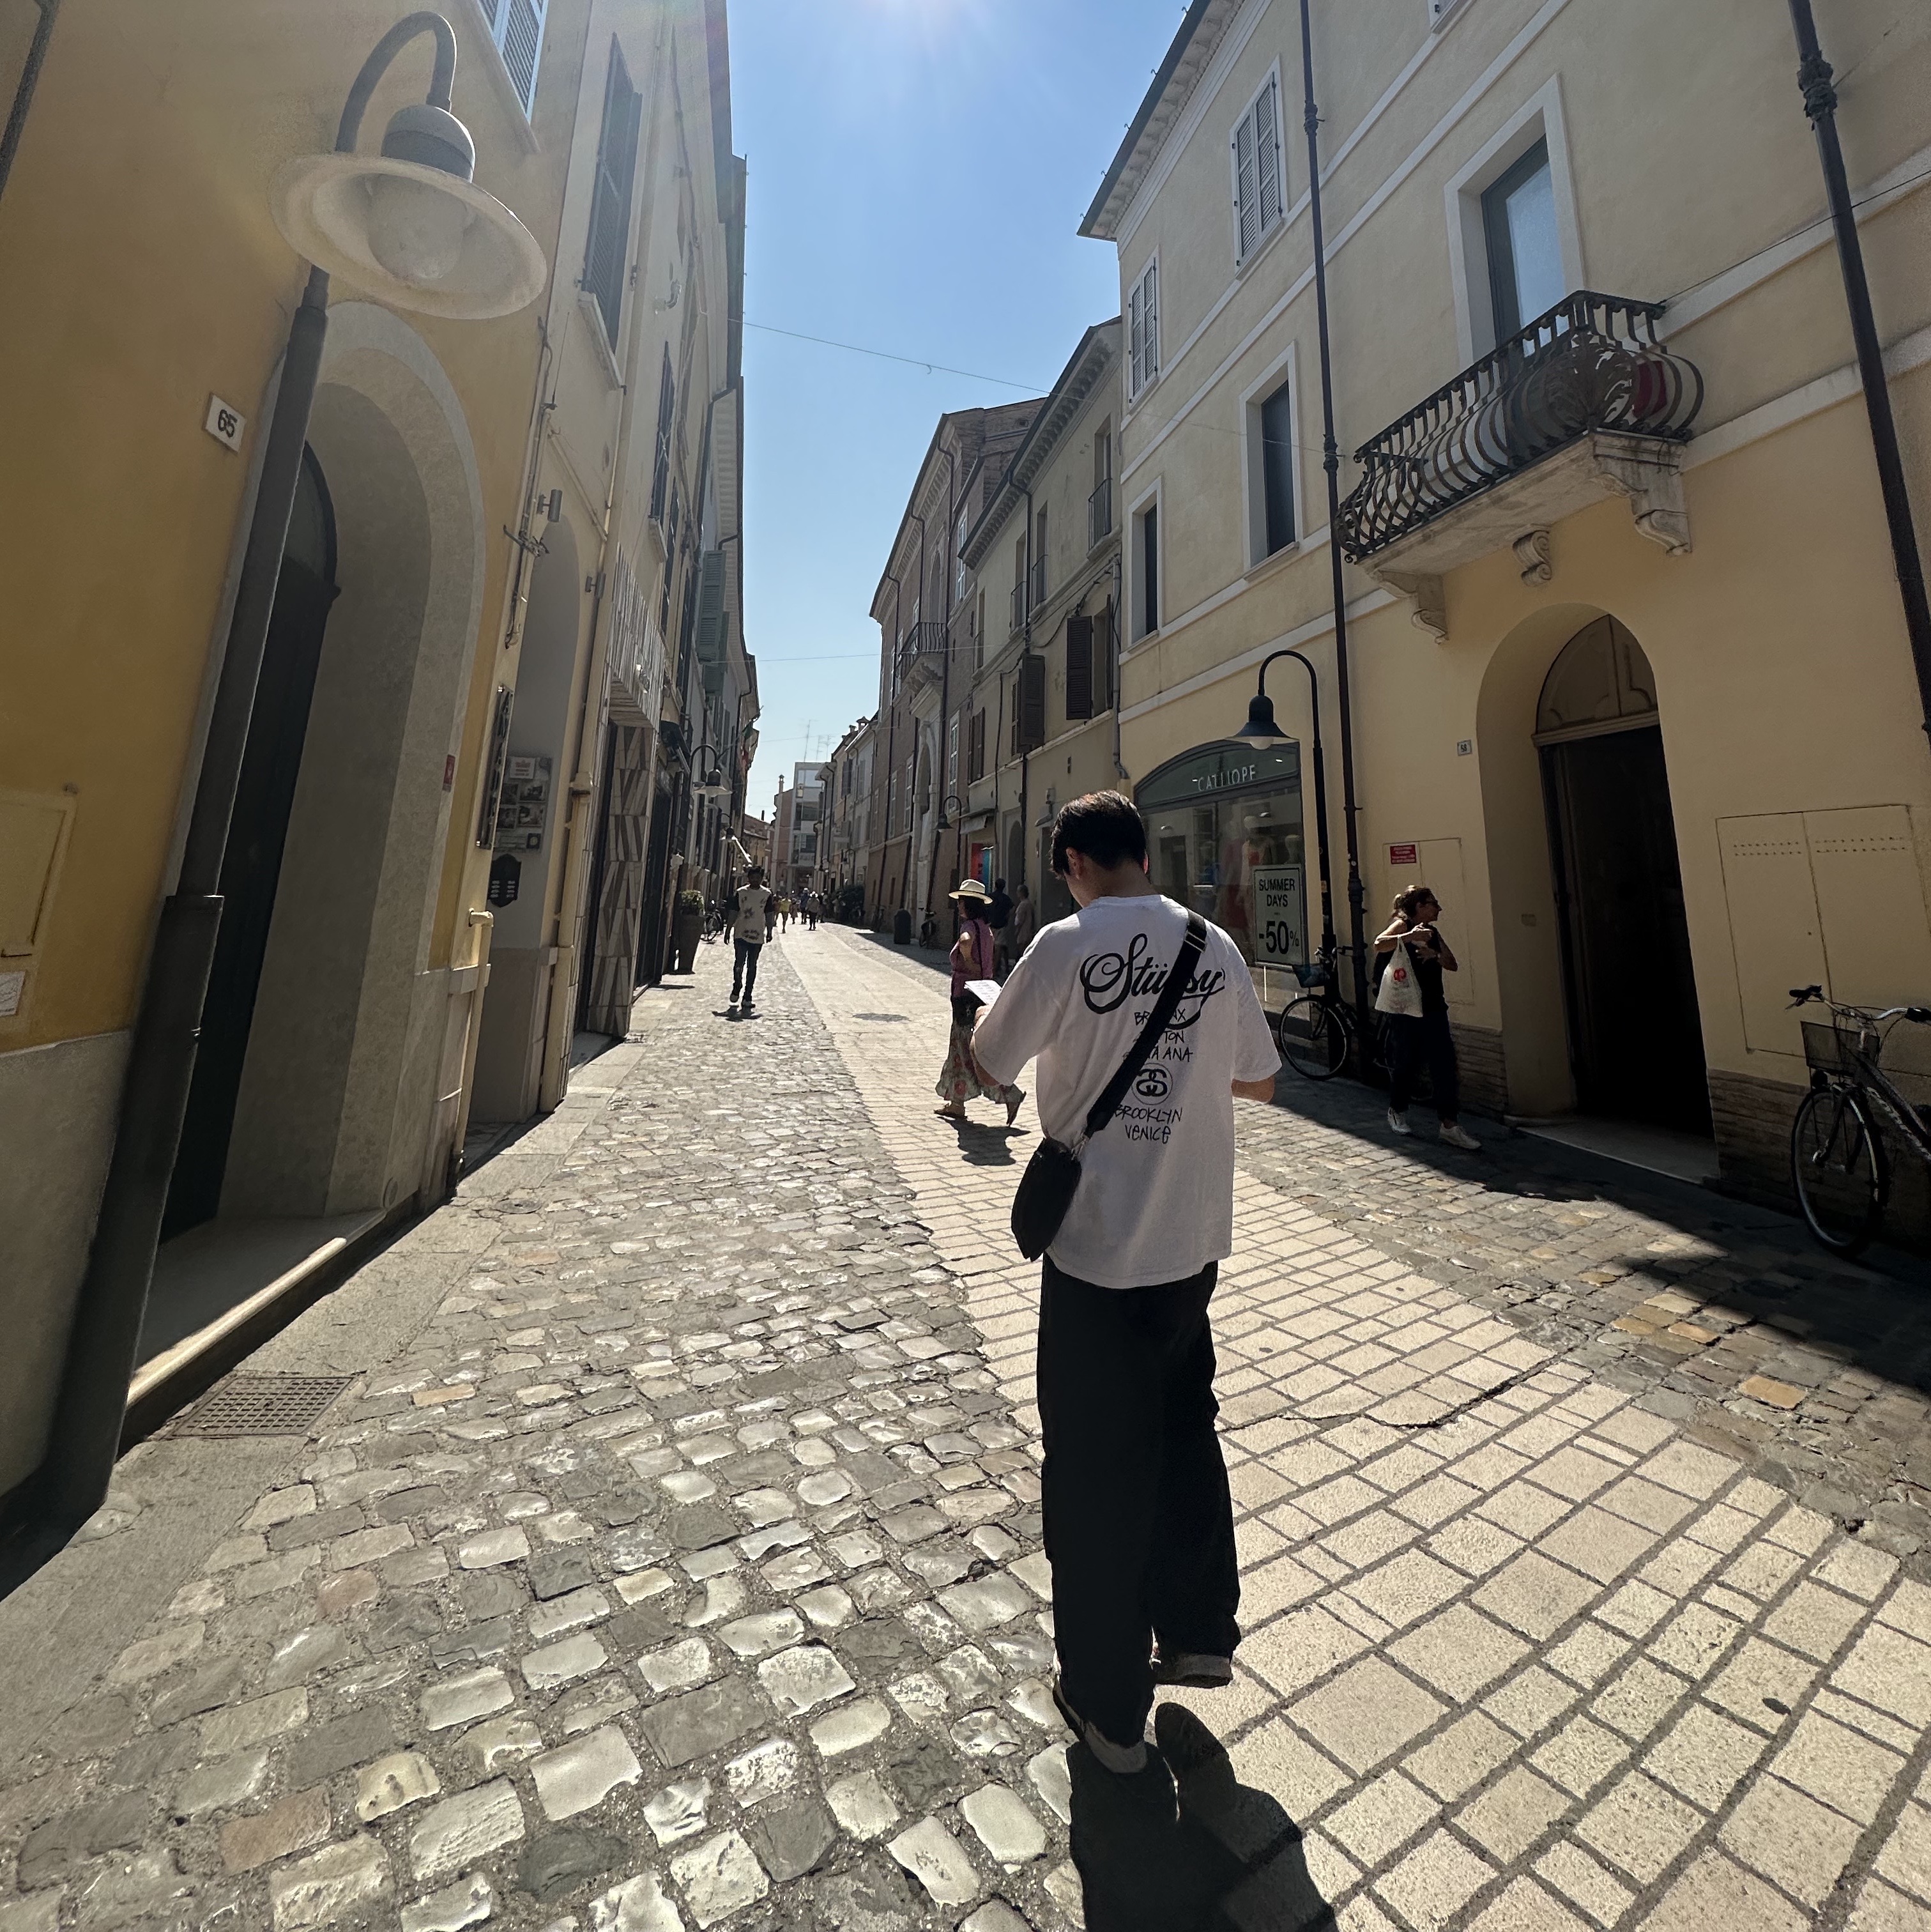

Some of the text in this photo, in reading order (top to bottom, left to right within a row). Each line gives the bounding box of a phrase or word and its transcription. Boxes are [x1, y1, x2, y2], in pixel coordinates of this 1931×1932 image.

[218, 409, 238, 438] 65
[1258, 878, 1295, 891] SUMMER
[1266, 894, 1288, 908] DAYS
[1258, 920, 1300, 954] -50%
[1162, 1046, 1194, 1062] ANA
